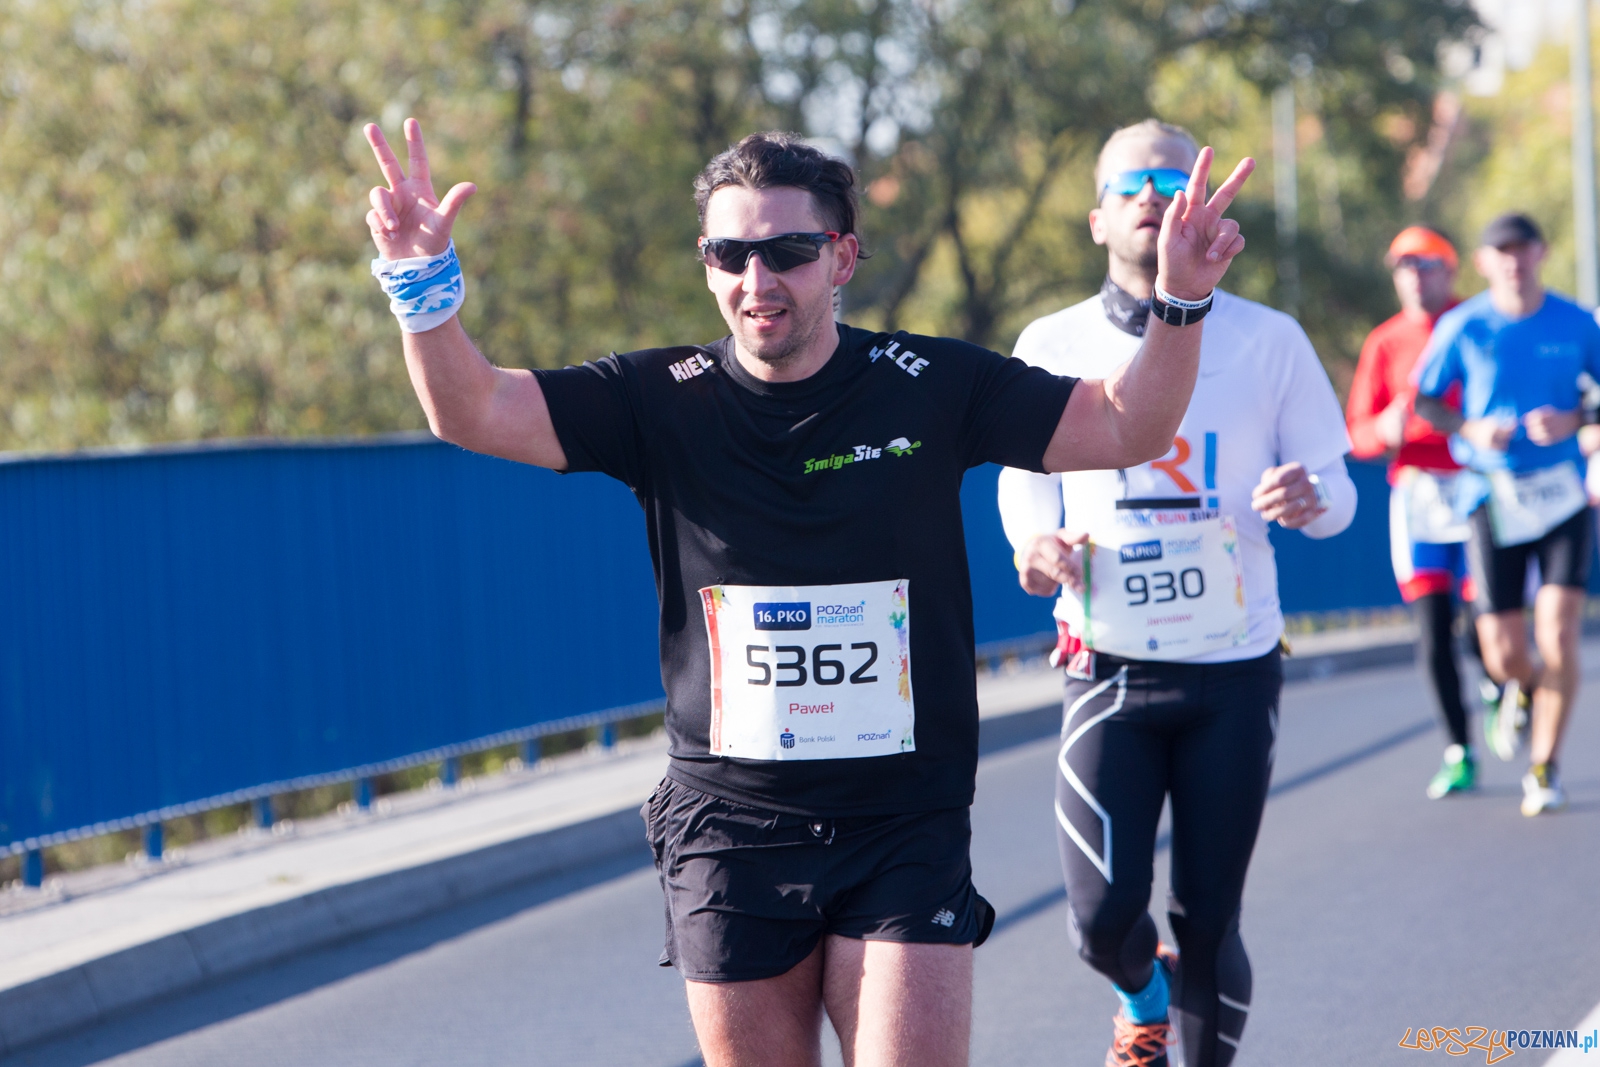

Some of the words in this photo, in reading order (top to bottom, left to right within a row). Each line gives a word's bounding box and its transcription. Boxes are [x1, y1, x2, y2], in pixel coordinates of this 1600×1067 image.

[1125, 567, 1206, 607] 930
[777, 610, 807, 623] PKO
[817, 613, 864, 624] maraton
[746, 641, 879, 687] 5362
[789, 702, 835, 715] Paweł
[817, 734, 836, 743] Polski
